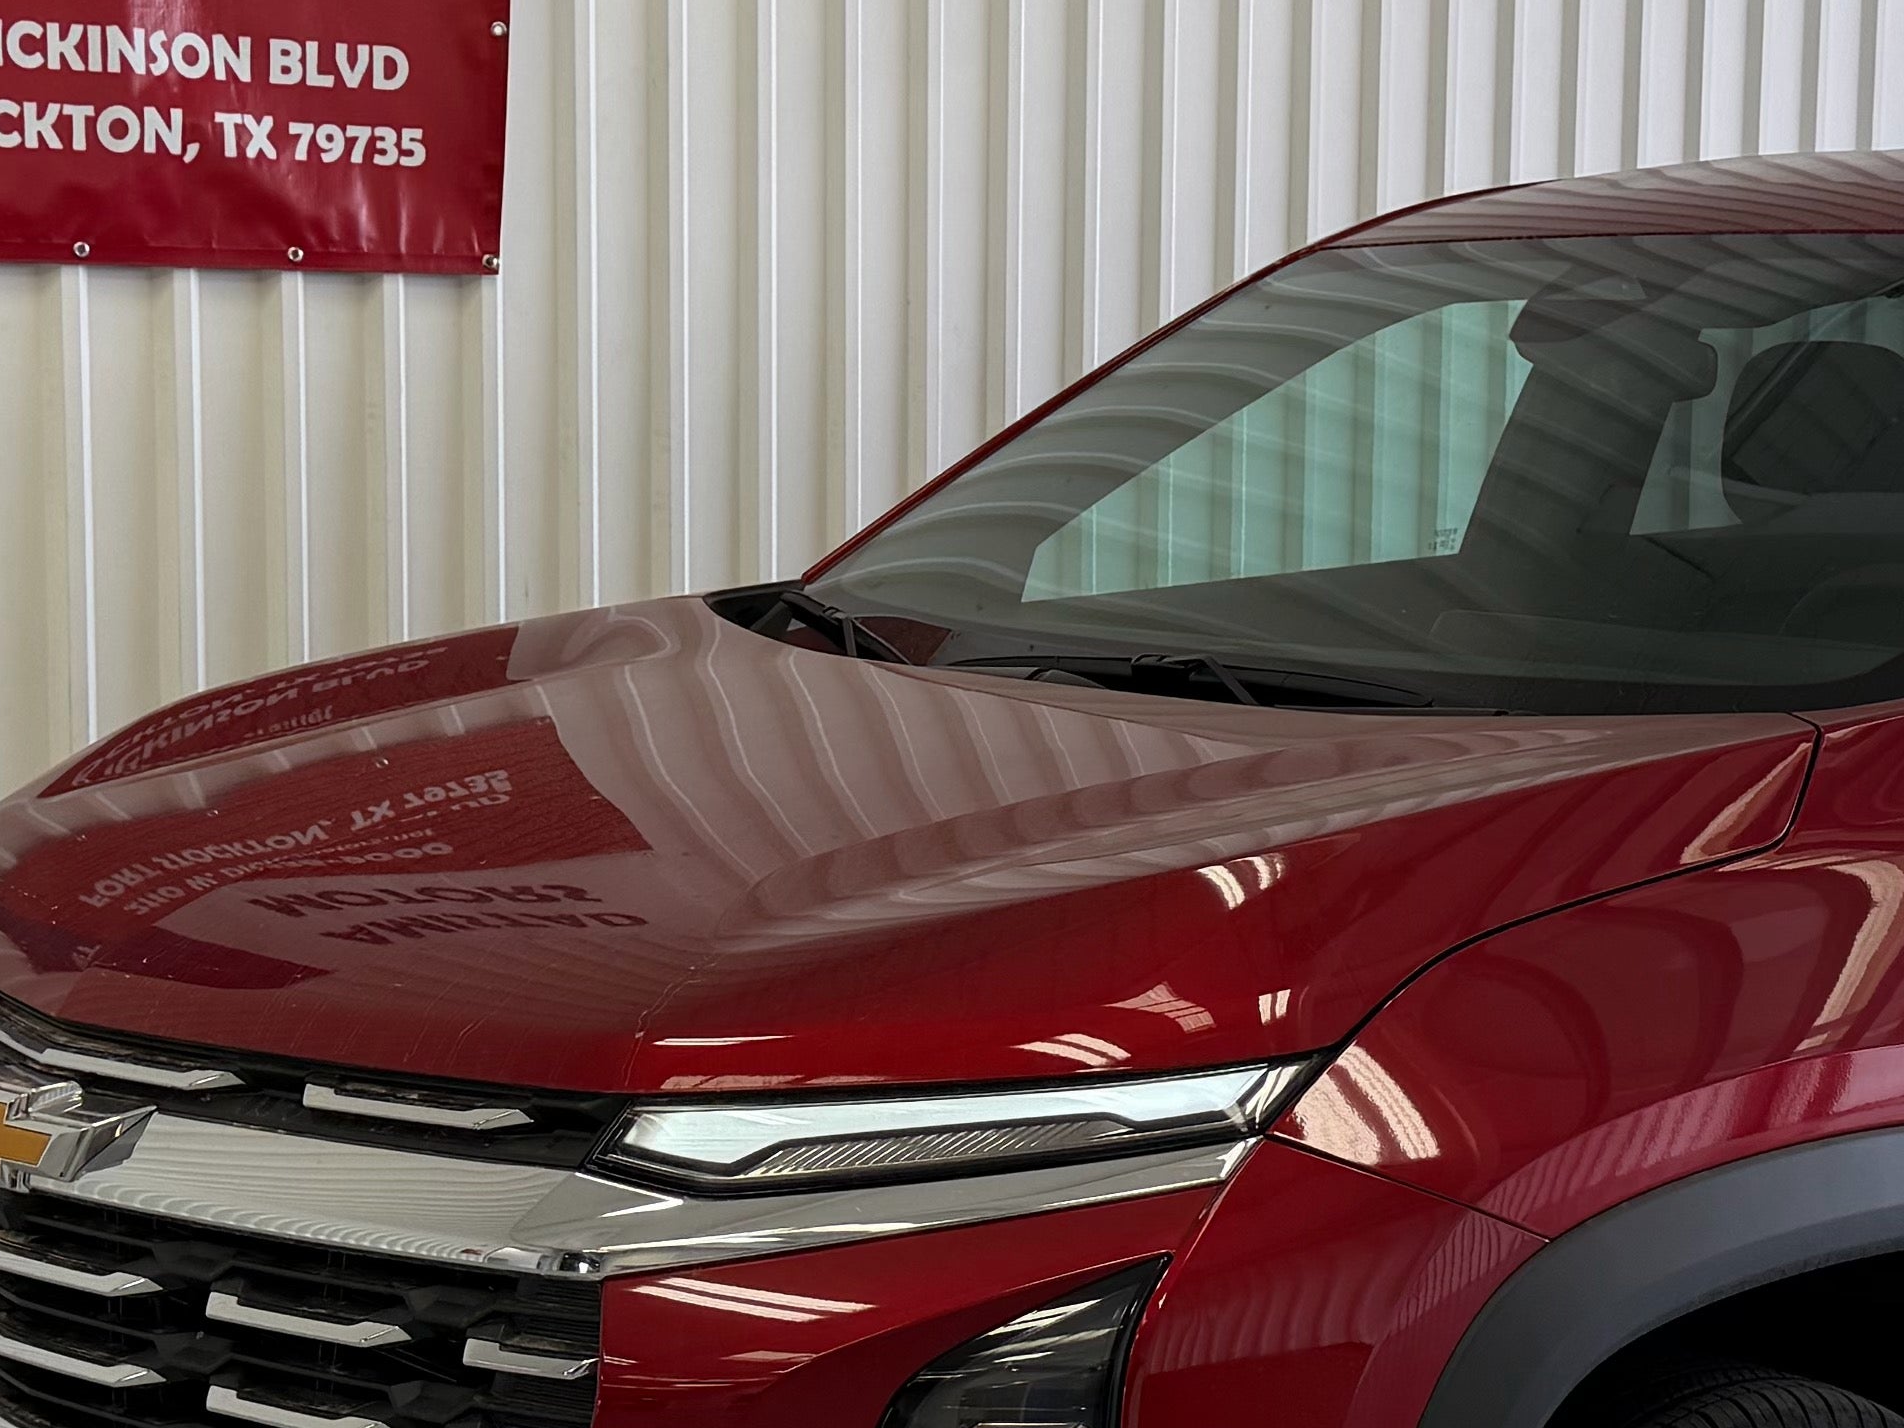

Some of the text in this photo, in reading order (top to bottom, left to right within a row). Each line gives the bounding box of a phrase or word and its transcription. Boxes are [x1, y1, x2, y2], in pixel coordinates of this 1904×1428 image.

[268, 36, 410, 92] BLVD
[214, 111, 278, 161] TX
[288, 120, 427, 169] 79735
